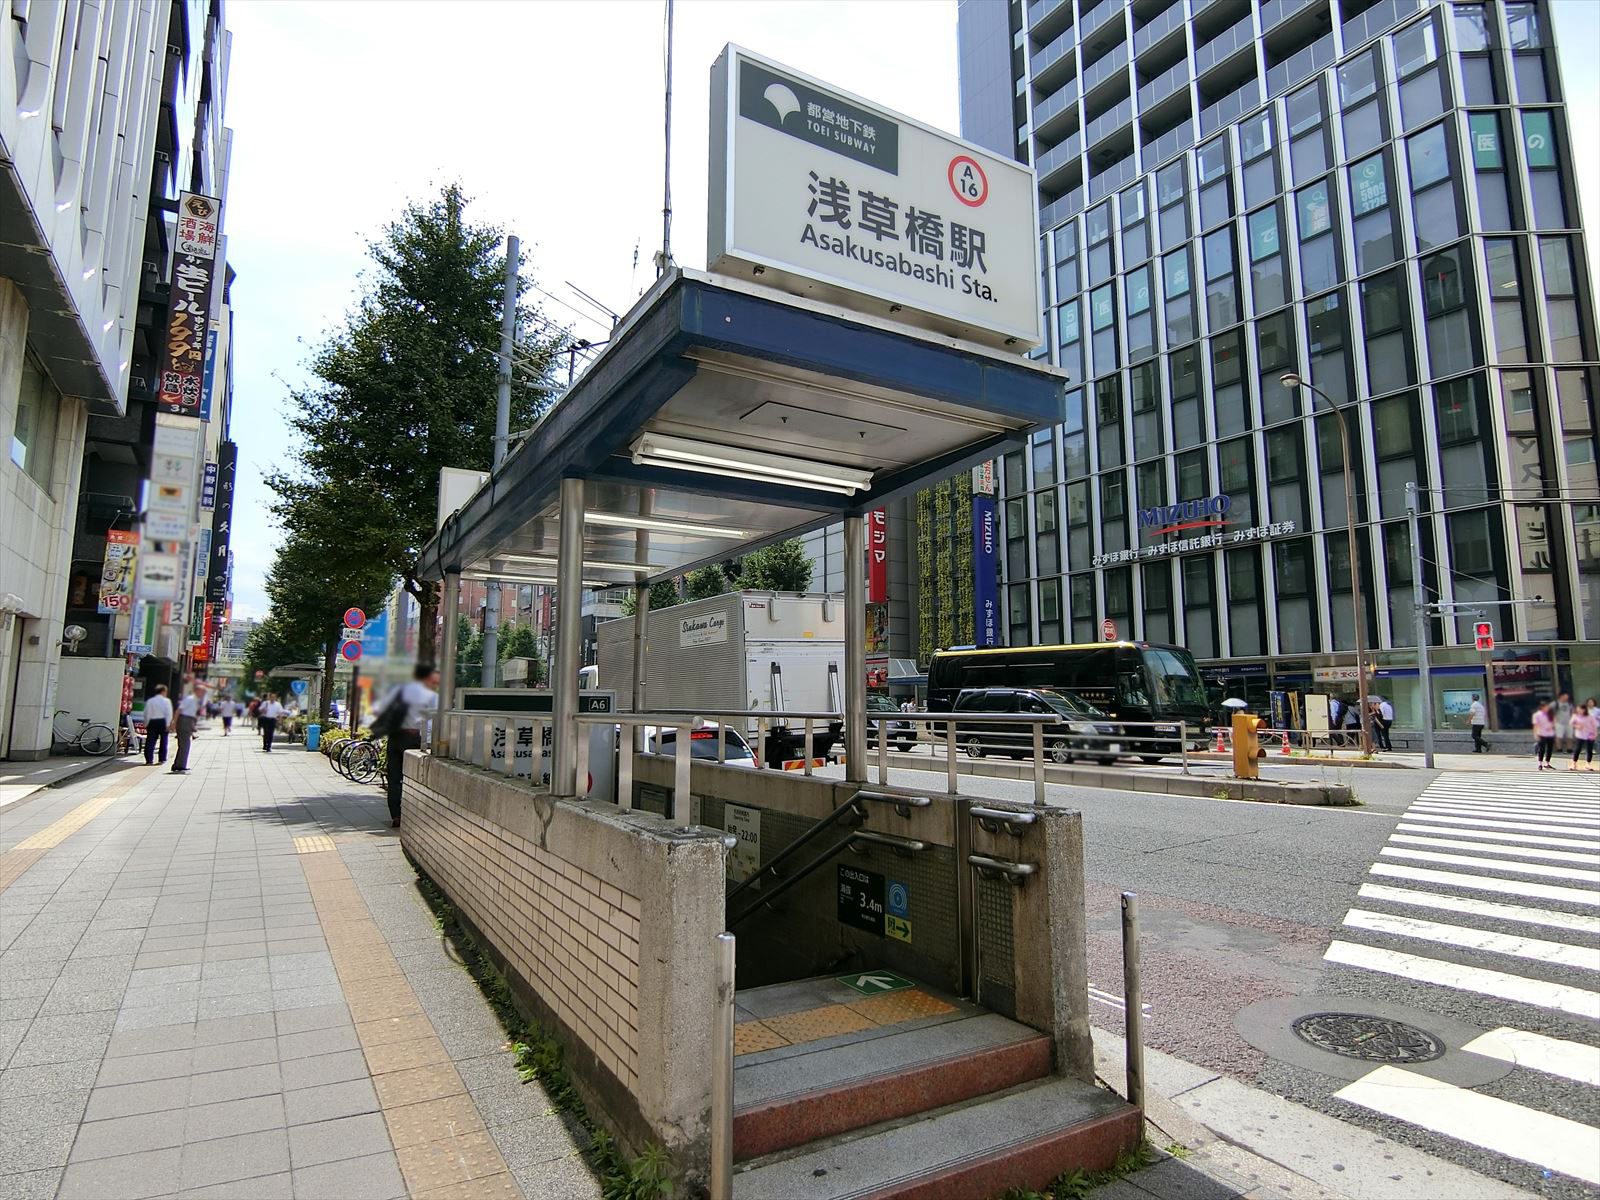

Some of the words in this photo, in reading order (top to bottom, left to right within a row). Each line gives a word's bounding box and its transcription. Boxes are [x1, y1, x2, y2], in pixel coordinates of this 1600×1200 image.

[807, 102, 877, 142] 都営地下鉄
[807, 119, 831, 139] TOEI
[834, 126, 877, 155] SUBWAY
[959, 180, 979, 199] 16
[962, 165, 975, 181] A
[179, 216, 197, 242] 酒場
[197, 221, 216, 247] 海鮮
[807, 170, 989, 275] 浅草橋駅
[800, 223, 955, 290] Asakusabashi
[961, 273, 999, 304] Sta.
[174, 264, 210, 315] 生ビール
[1138, 494, 1232, 530] MIZUHO
[1091, 548, 1139, 566] みずほ銀行
[1147, 533, 1223, 556] みずほ信託銀行
[1233, 520, 1296, 542] みずほ証券
[591, 700, 606, 709] A6
[859, 892, 883, 914] 3.4m
